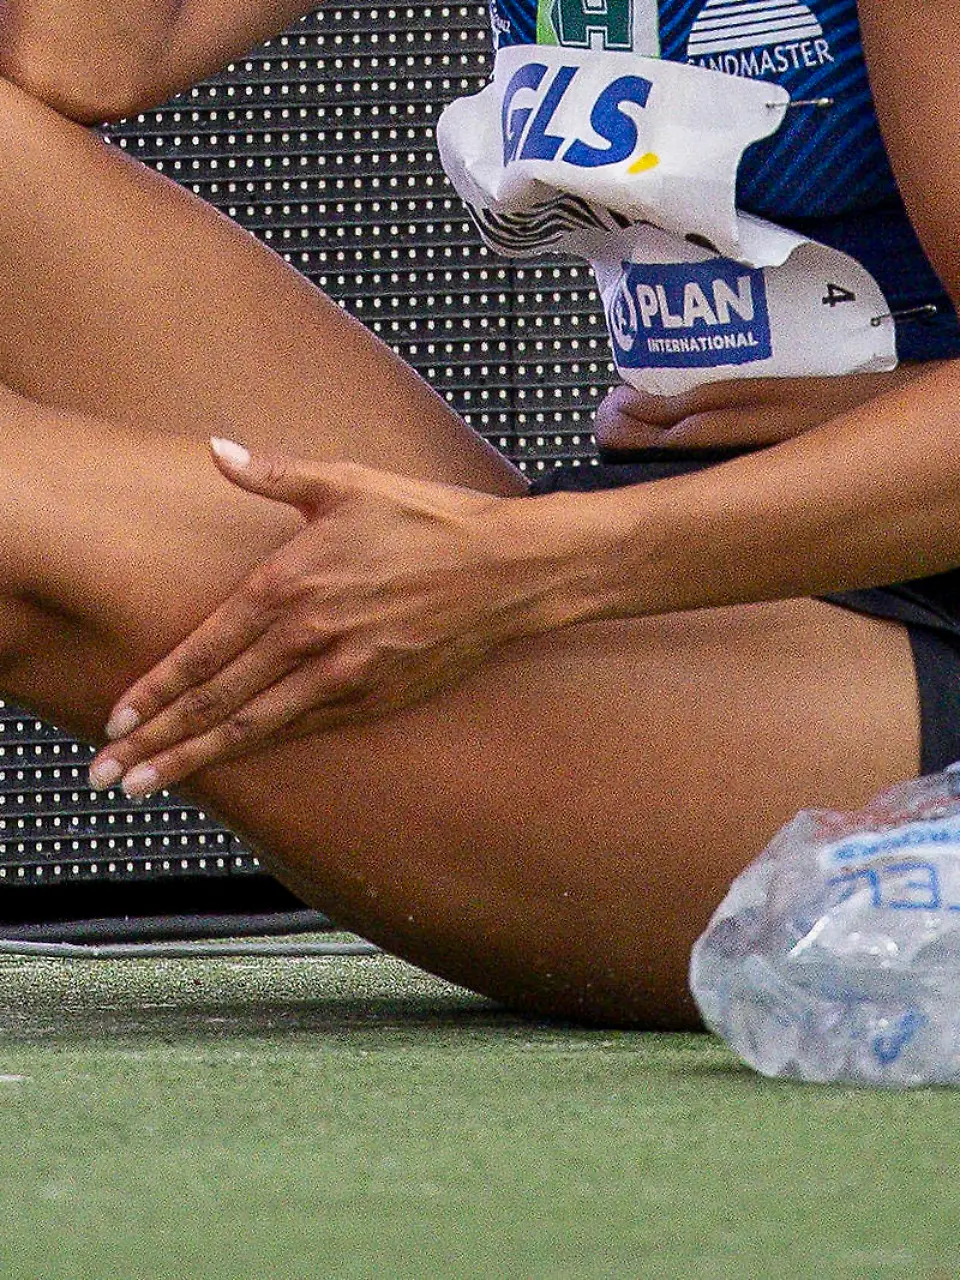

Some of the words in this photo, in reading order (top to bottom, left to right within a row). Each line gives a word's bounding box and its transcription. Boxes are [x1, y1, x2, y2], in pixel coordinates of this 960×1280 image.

[687, 38, 835, 77] ANDMASTER
[502, 62, 653, 169] GLS
[635, 275, 755, 329] PLAN
[647, 332, 759, 353] INTERNATIONAL
